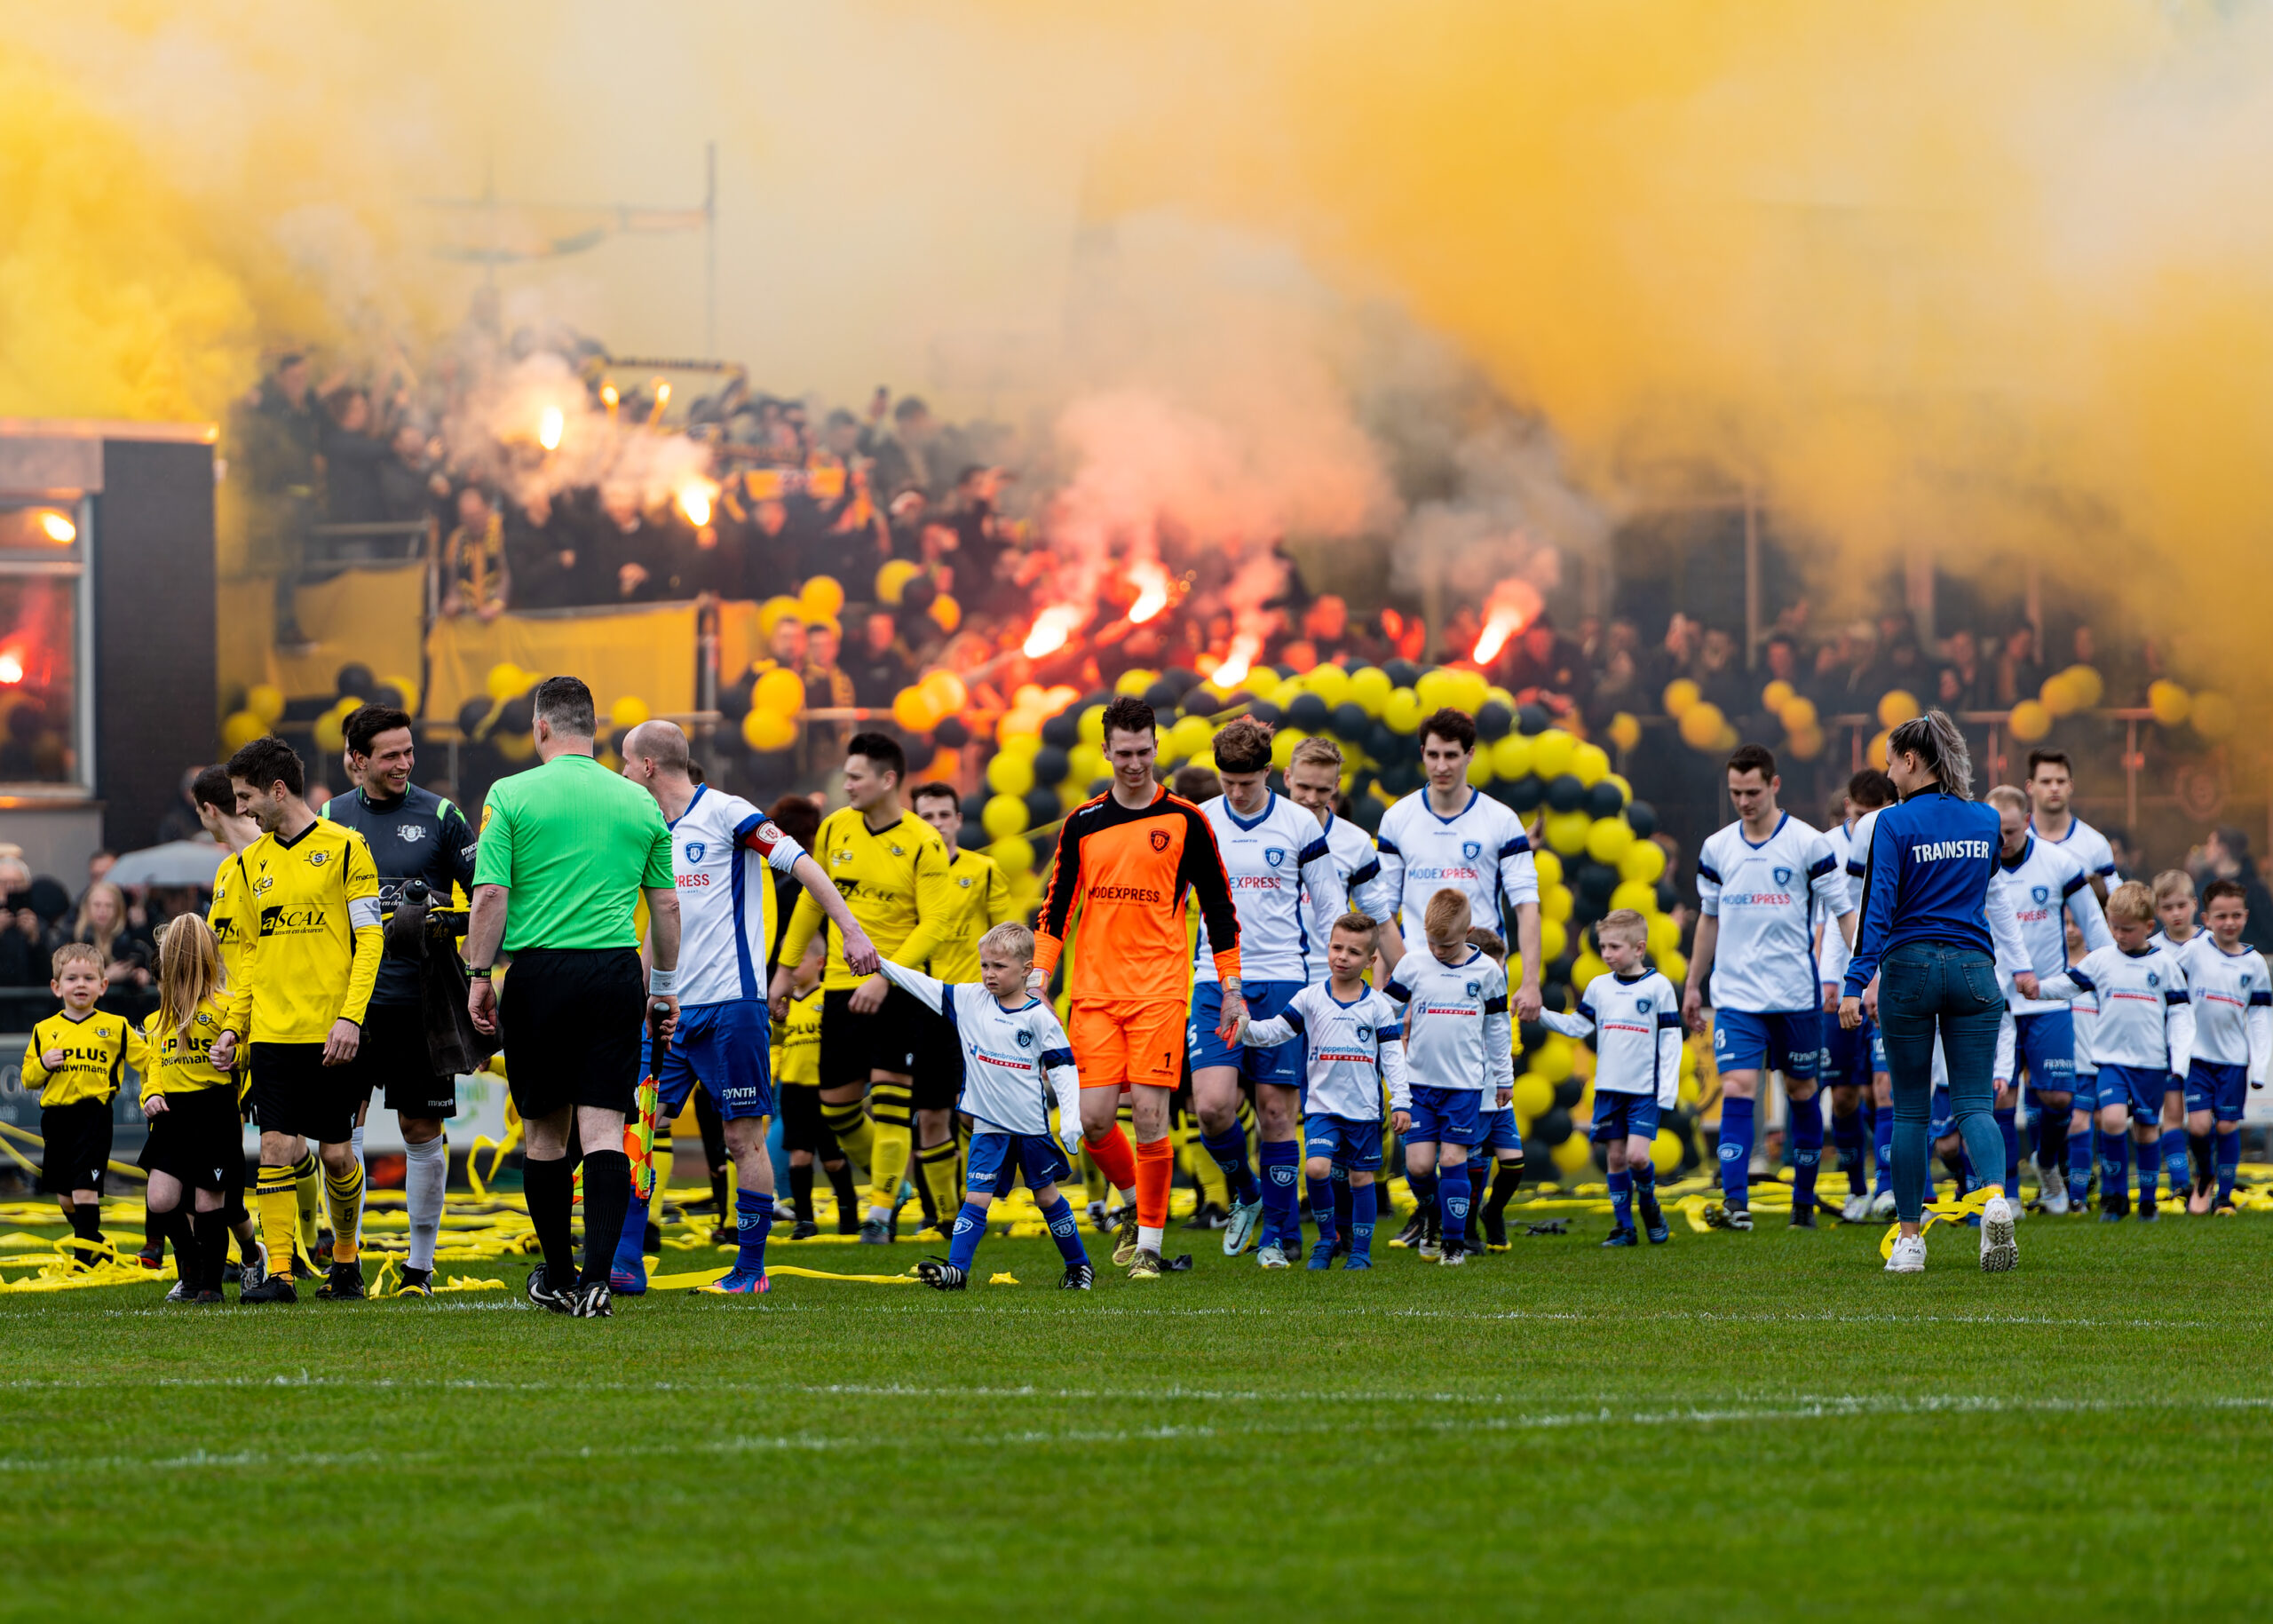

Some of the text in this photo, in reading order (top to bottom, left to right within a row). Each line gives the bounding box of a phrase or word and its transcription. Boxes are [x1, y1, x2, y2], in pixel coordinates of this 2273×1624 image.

[1912, 840, 1990, 863] TRAINSTER
[1088, 886, 1160, 903] MODEXPRESS
[168, 1037, 213, 1052] PUS
[62, 1048, 107, 1063] PLUS
[1164, 1052, 1171, 1068] 1
[56, 1064, 107, 1077] ouwmans
